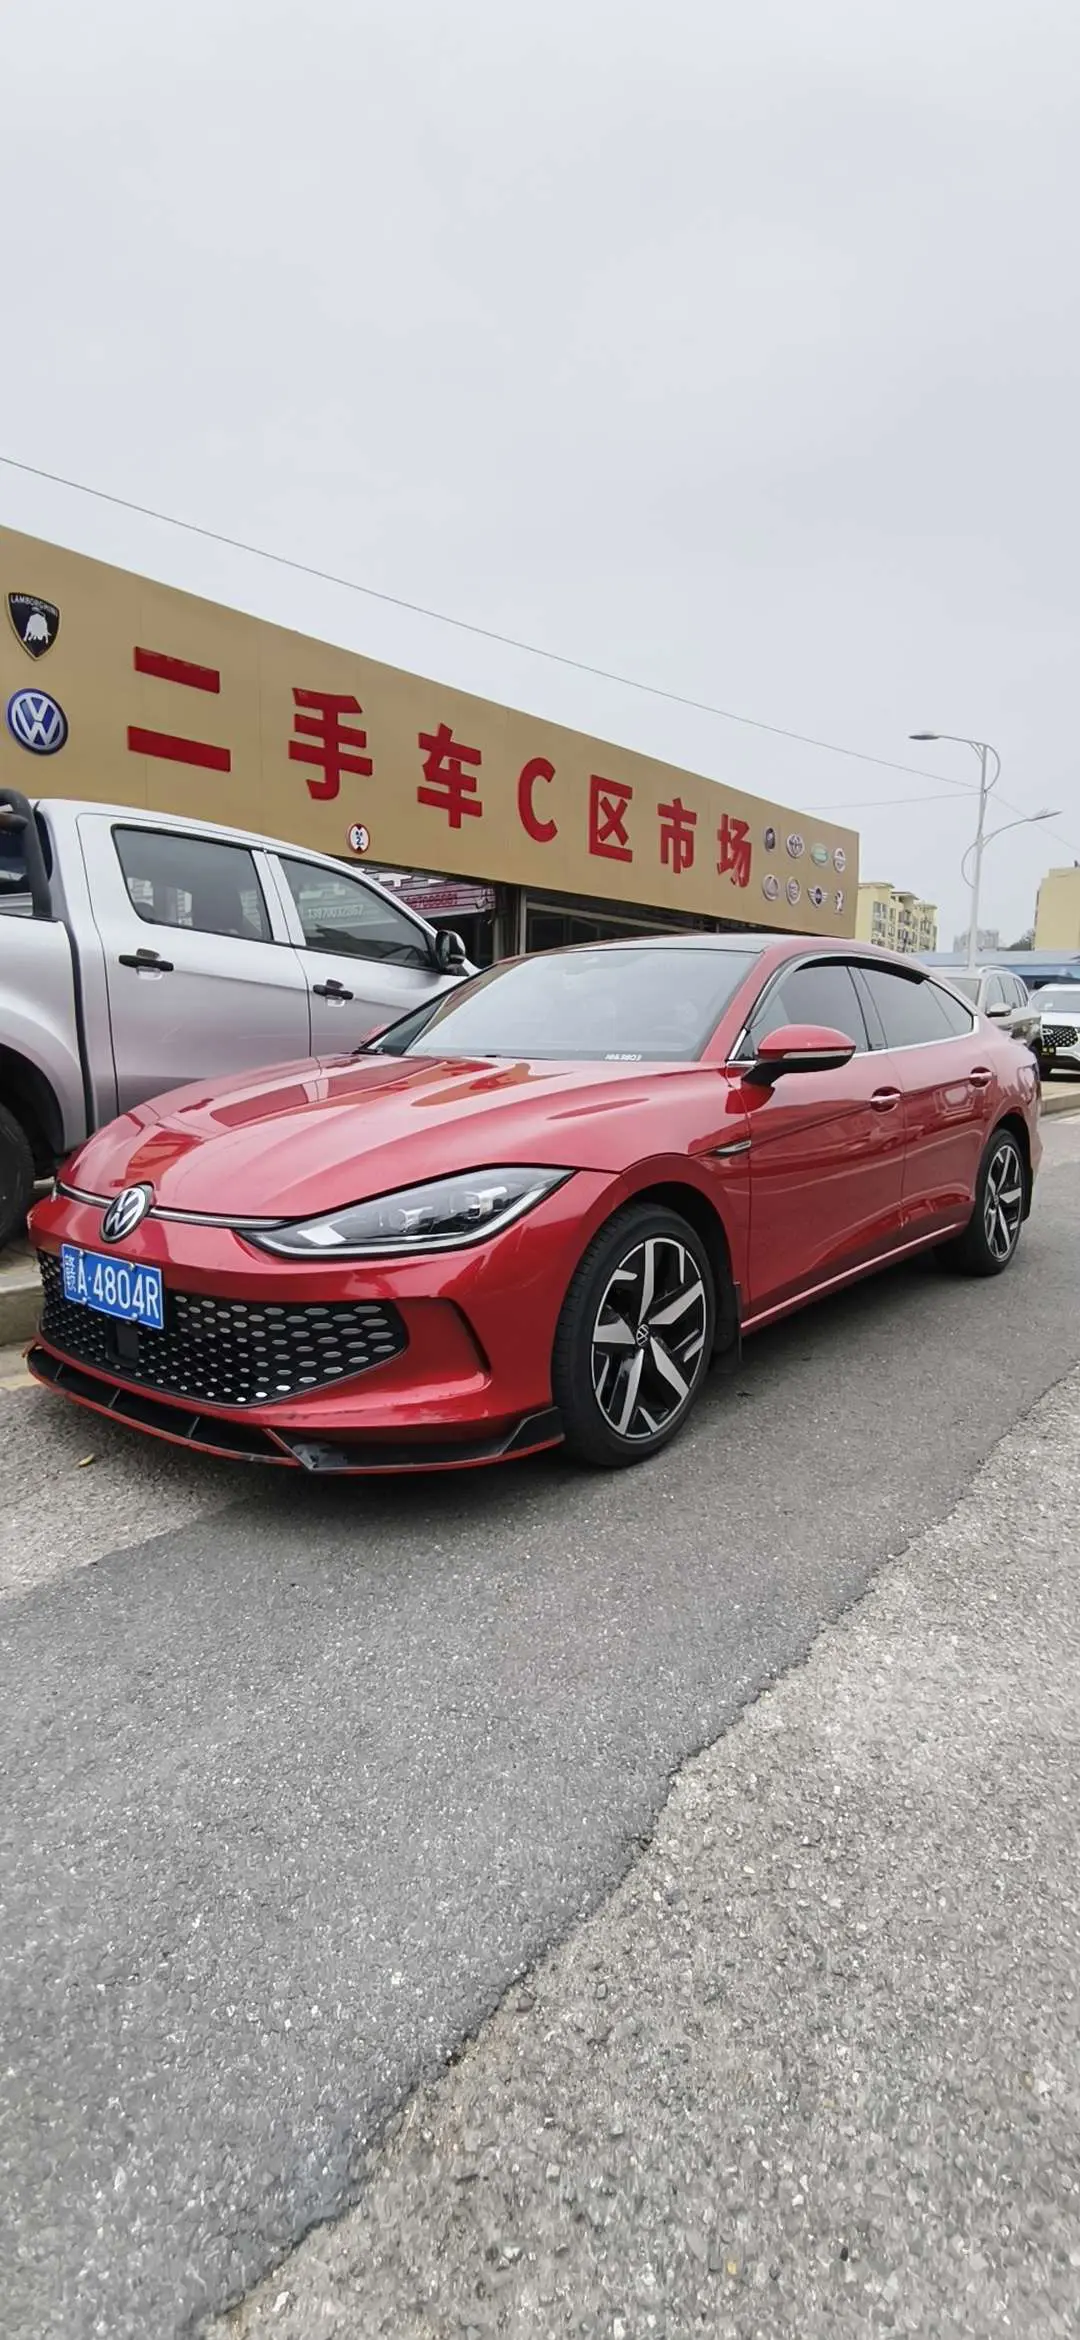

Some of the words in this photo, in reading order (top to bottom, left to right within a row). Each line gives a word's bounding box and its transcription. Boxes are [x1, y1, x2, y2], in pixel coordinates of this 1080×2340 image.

[127, 645, 752, 888] 二手车C区市场
